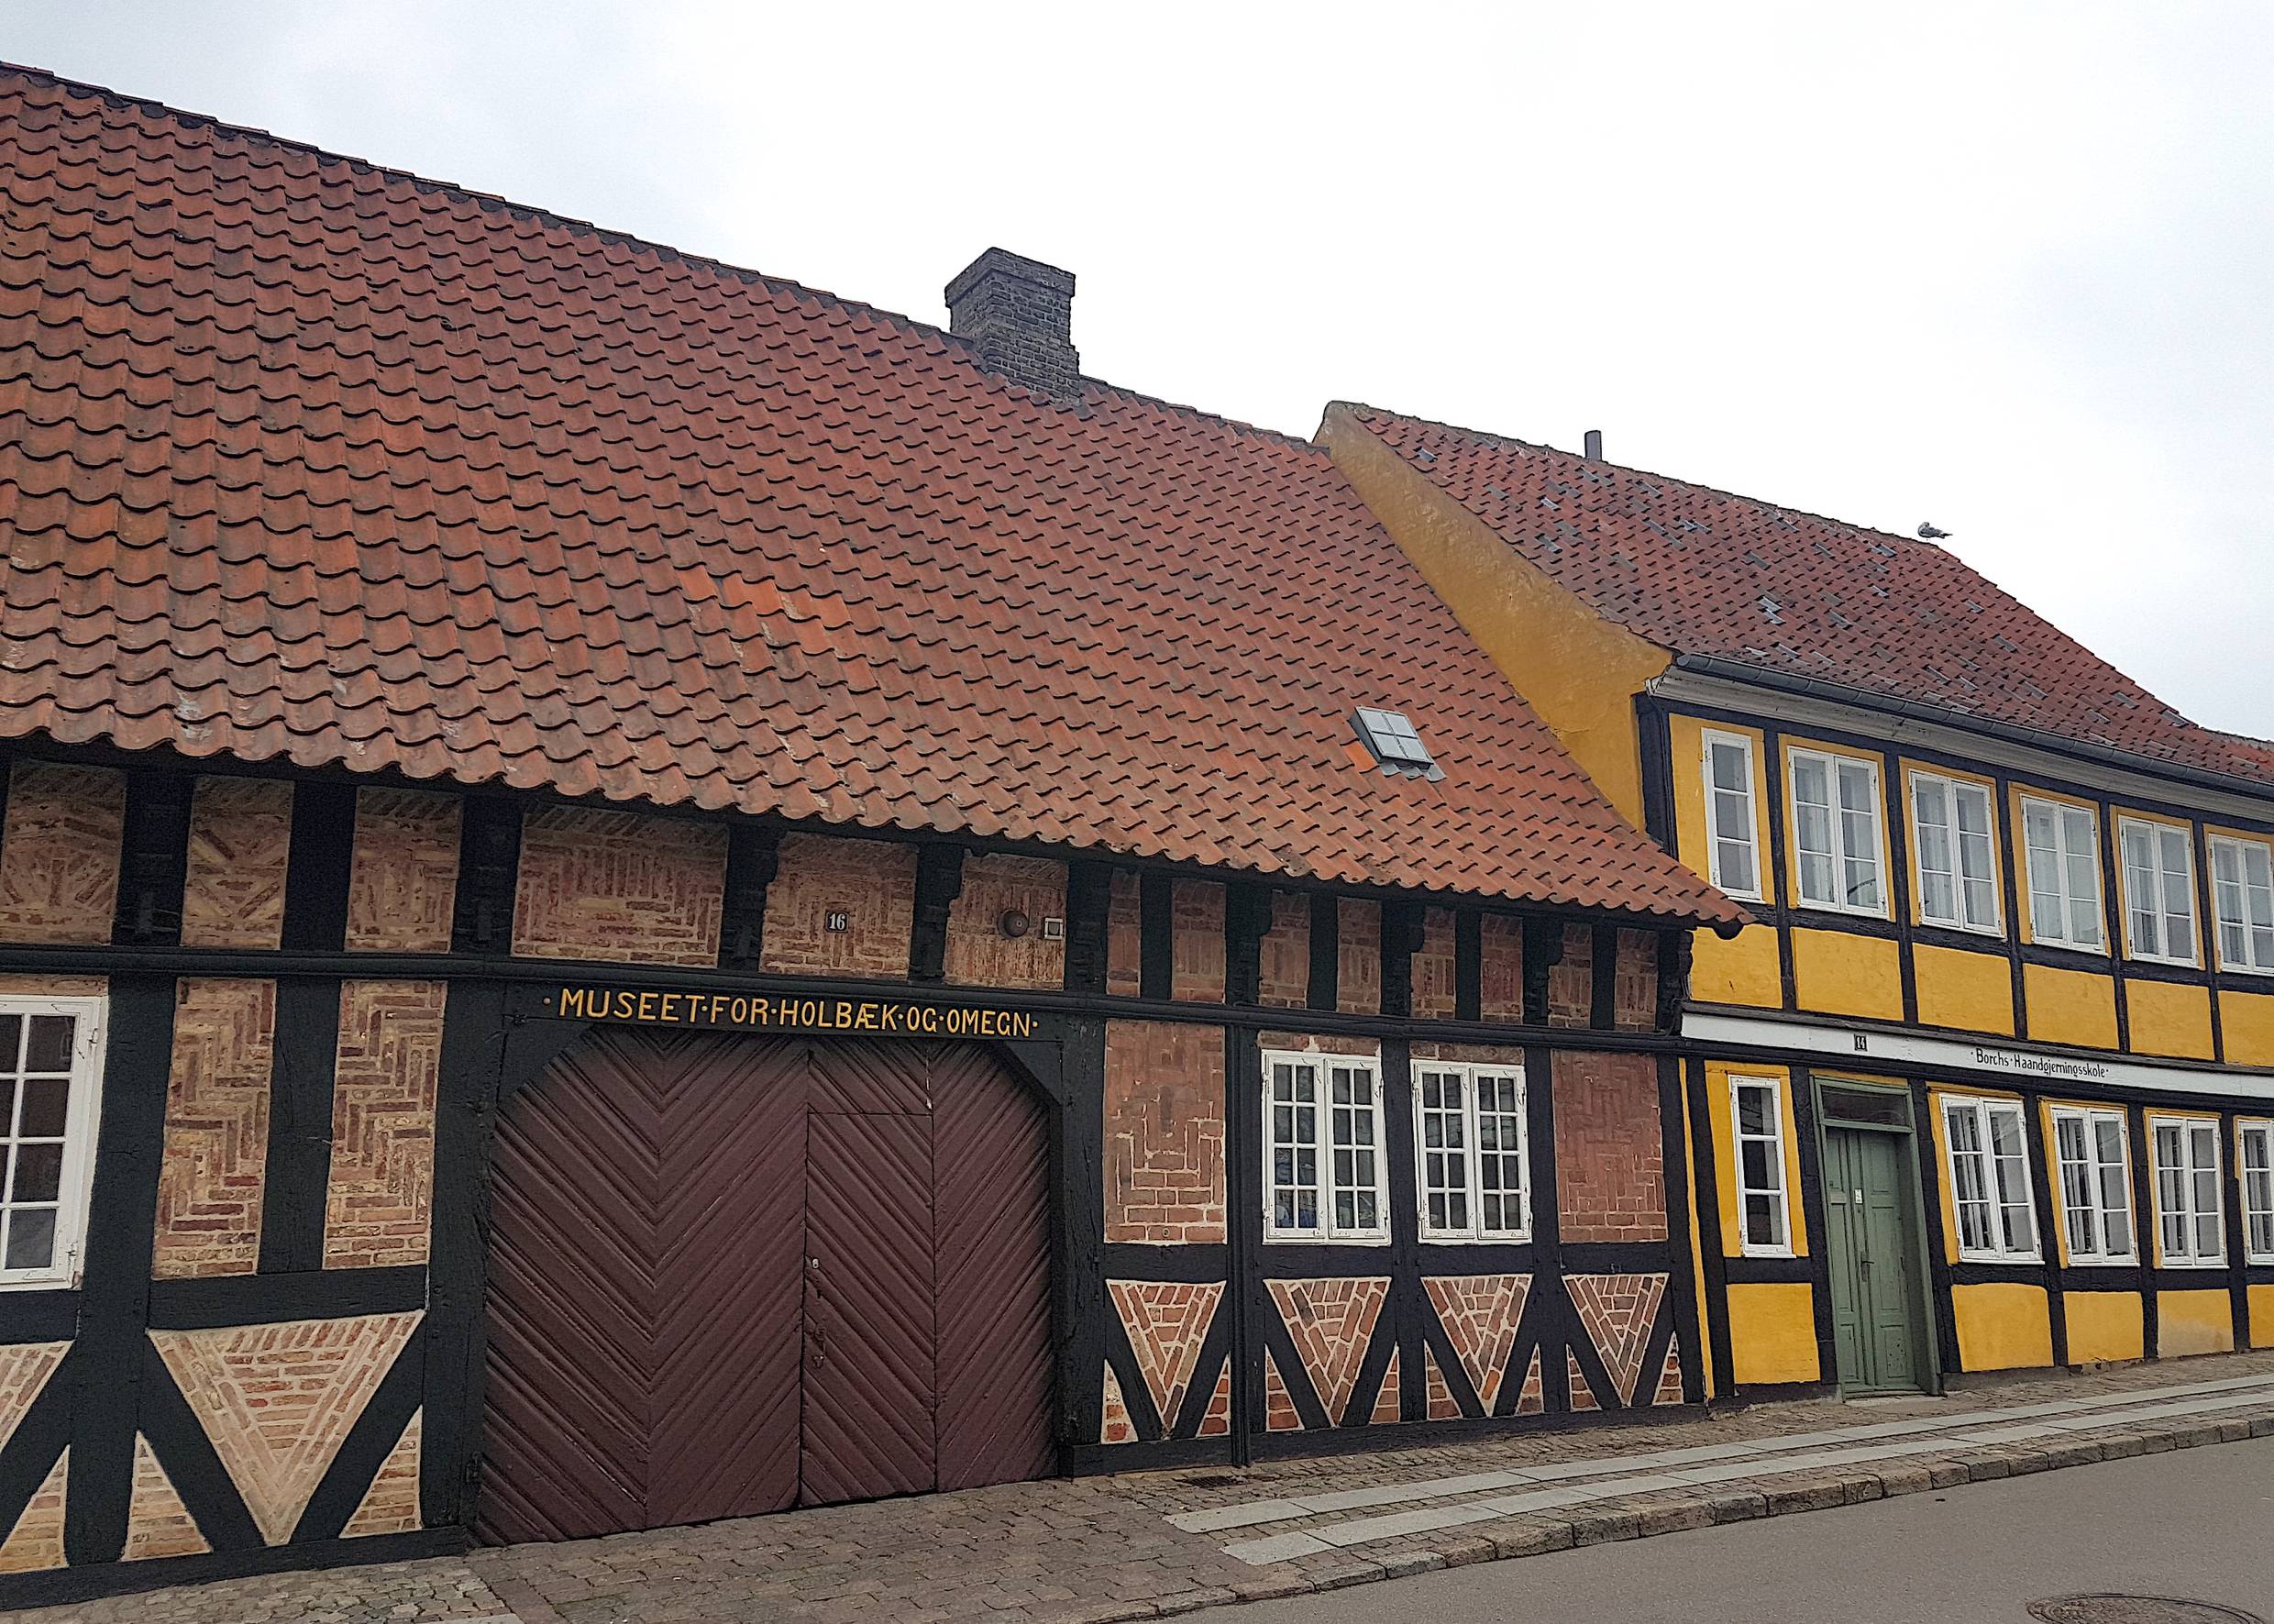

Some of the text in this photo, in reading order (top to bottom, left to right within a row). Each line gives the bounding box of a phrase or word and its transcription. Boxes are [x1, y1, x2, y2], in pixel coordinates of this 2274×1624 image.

[829, 912, 846, 931] 16
[558, 989, 1031, 1037] MUSEET FOR HOLBÆK OG OMEGN
[1856, 1036, 1866, 1049] 14
[1976, 1047, 2105, 1077] Borchs Haandgjerningsskole
